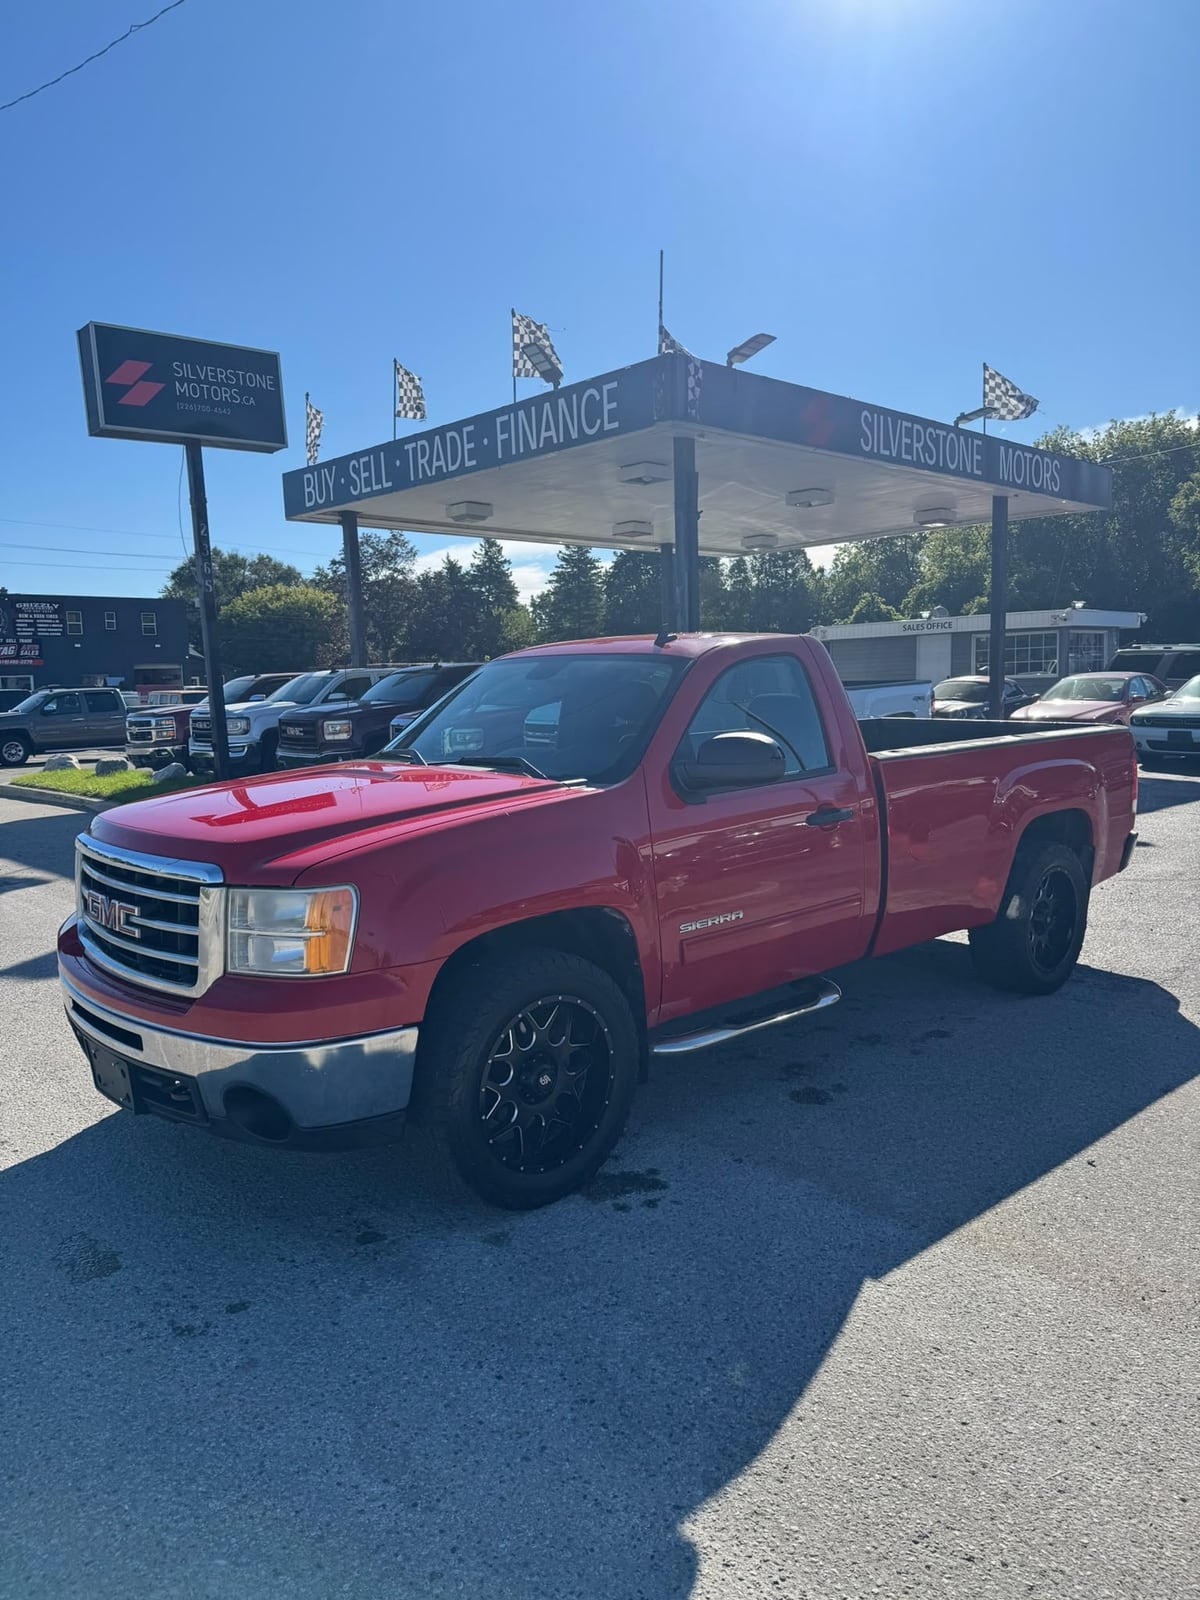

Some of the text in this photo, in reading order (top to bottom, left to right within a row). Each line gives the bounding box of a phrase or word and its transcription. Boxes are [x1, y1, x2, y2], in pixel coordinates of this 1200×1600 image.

[172, 361, 275, 391] SILVERSTONE
[303, 380, 620, 508] BUY SELL TRADE FINANCE
[859, 409, 1062, 493] SILVERSTONE MOTORS
[902, 621, 953, 632] SALES OFFICE
[87, 889, 142, 939] GMC
[679, 909, 744, 934] SIERRA
